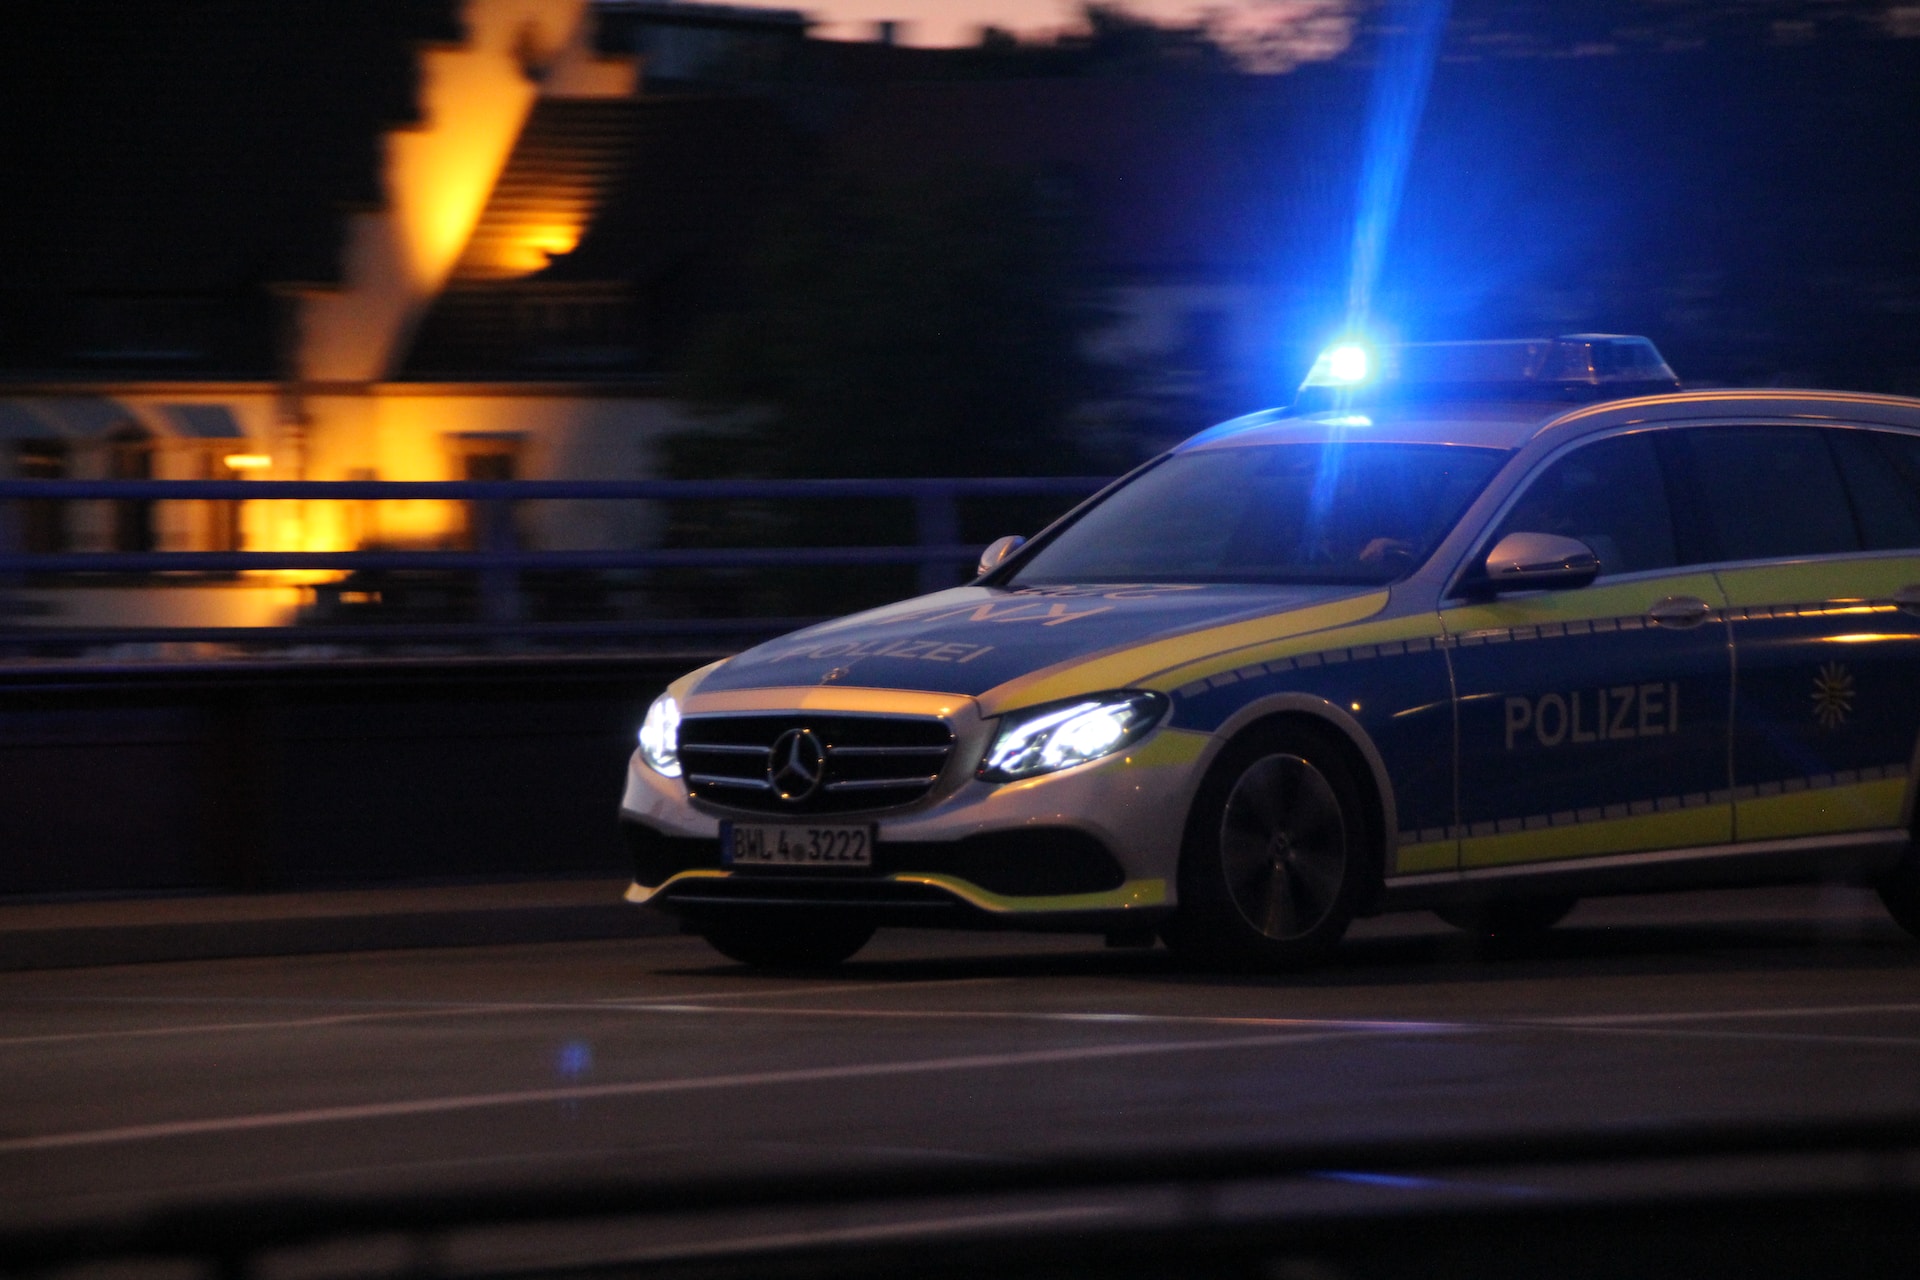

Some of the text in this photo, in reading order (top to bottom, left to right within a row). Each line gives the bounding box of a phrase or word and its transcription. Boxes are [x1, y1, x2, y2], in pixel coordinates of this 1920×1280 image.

[768, 640, 995, 664] POLIZEI
[1504, 683, 1679, 750] POLIZEI
[808, 829, 865, 861] 3222
